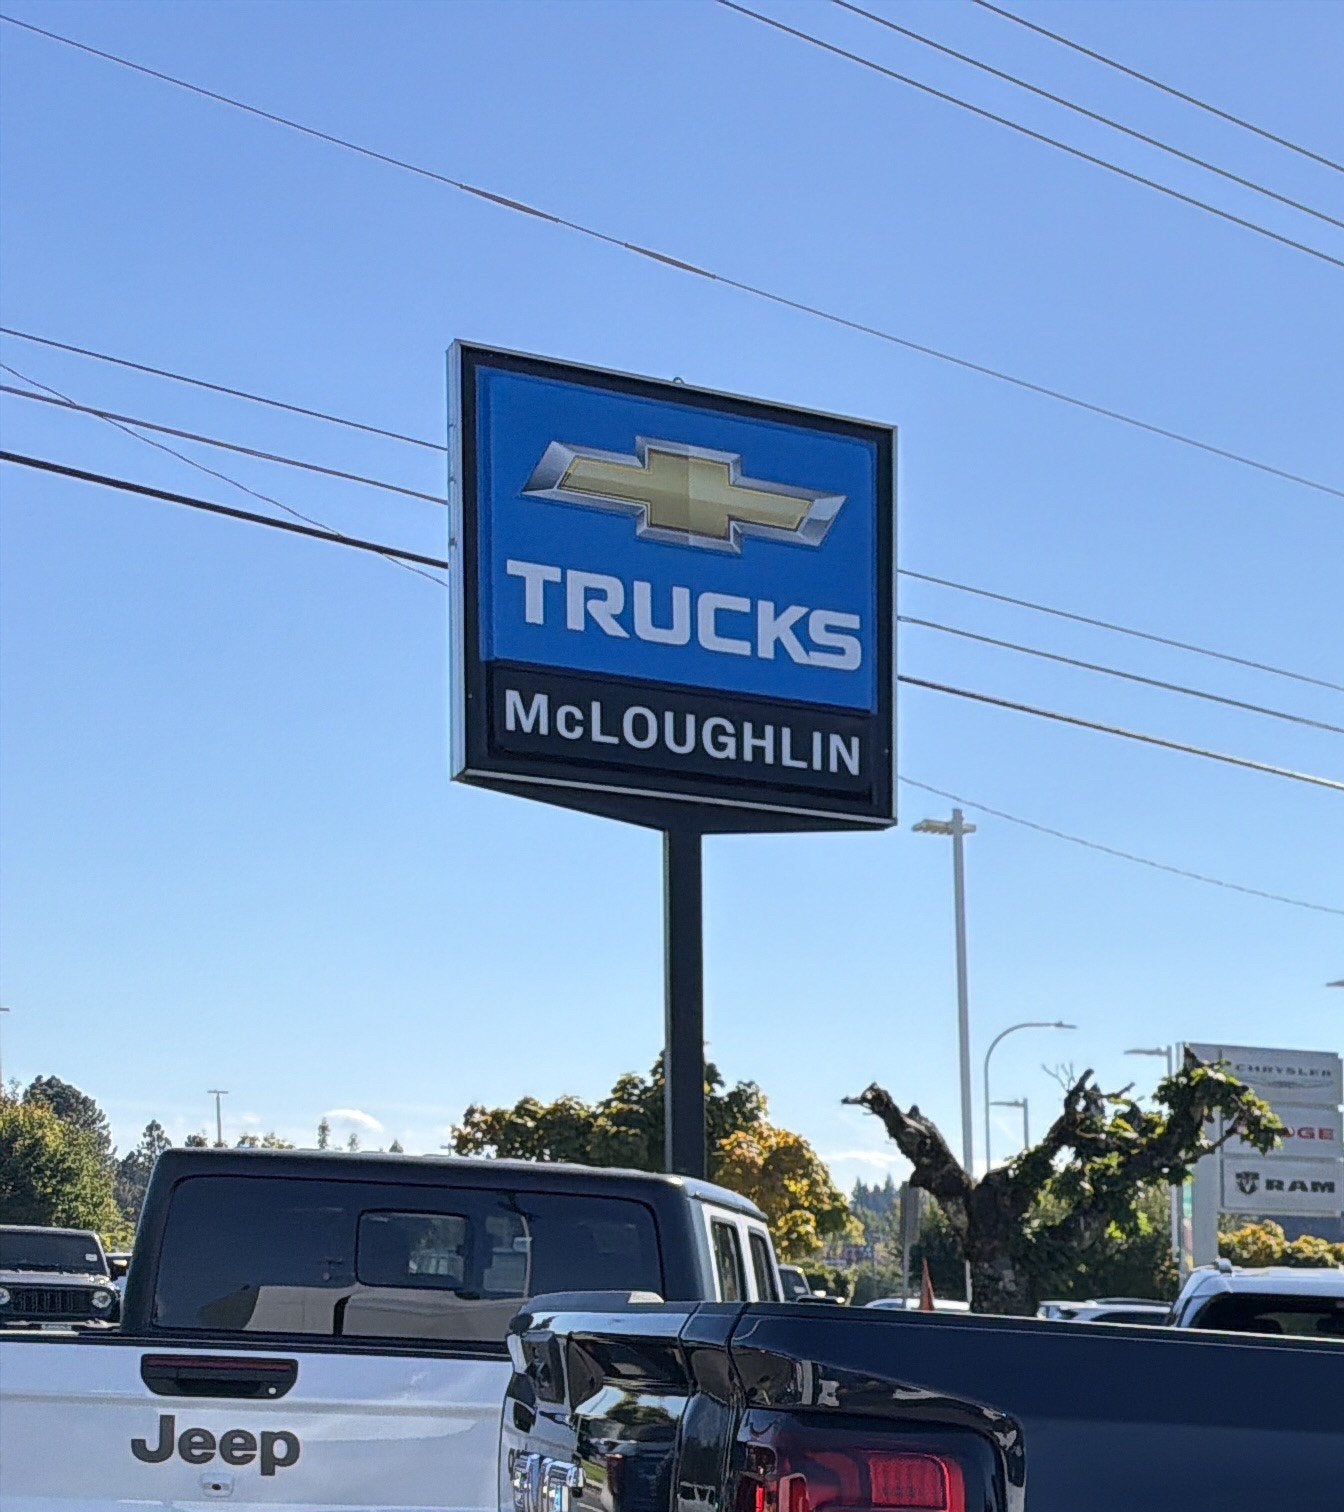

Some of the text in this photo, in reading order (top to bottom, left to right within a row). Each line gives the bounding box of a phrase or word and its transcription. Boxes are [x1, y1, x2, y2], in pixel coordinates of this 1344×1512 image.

[506, 558, 862, 671] TRUCKS
[504, 689, 861, 777] McLOUGHLIN
[1235, 1063, 1332, 1077] CHRYSLER
[1265, 1178, 1335, 1194] RAM
[130, 1414, 301, 1477] Jeep
